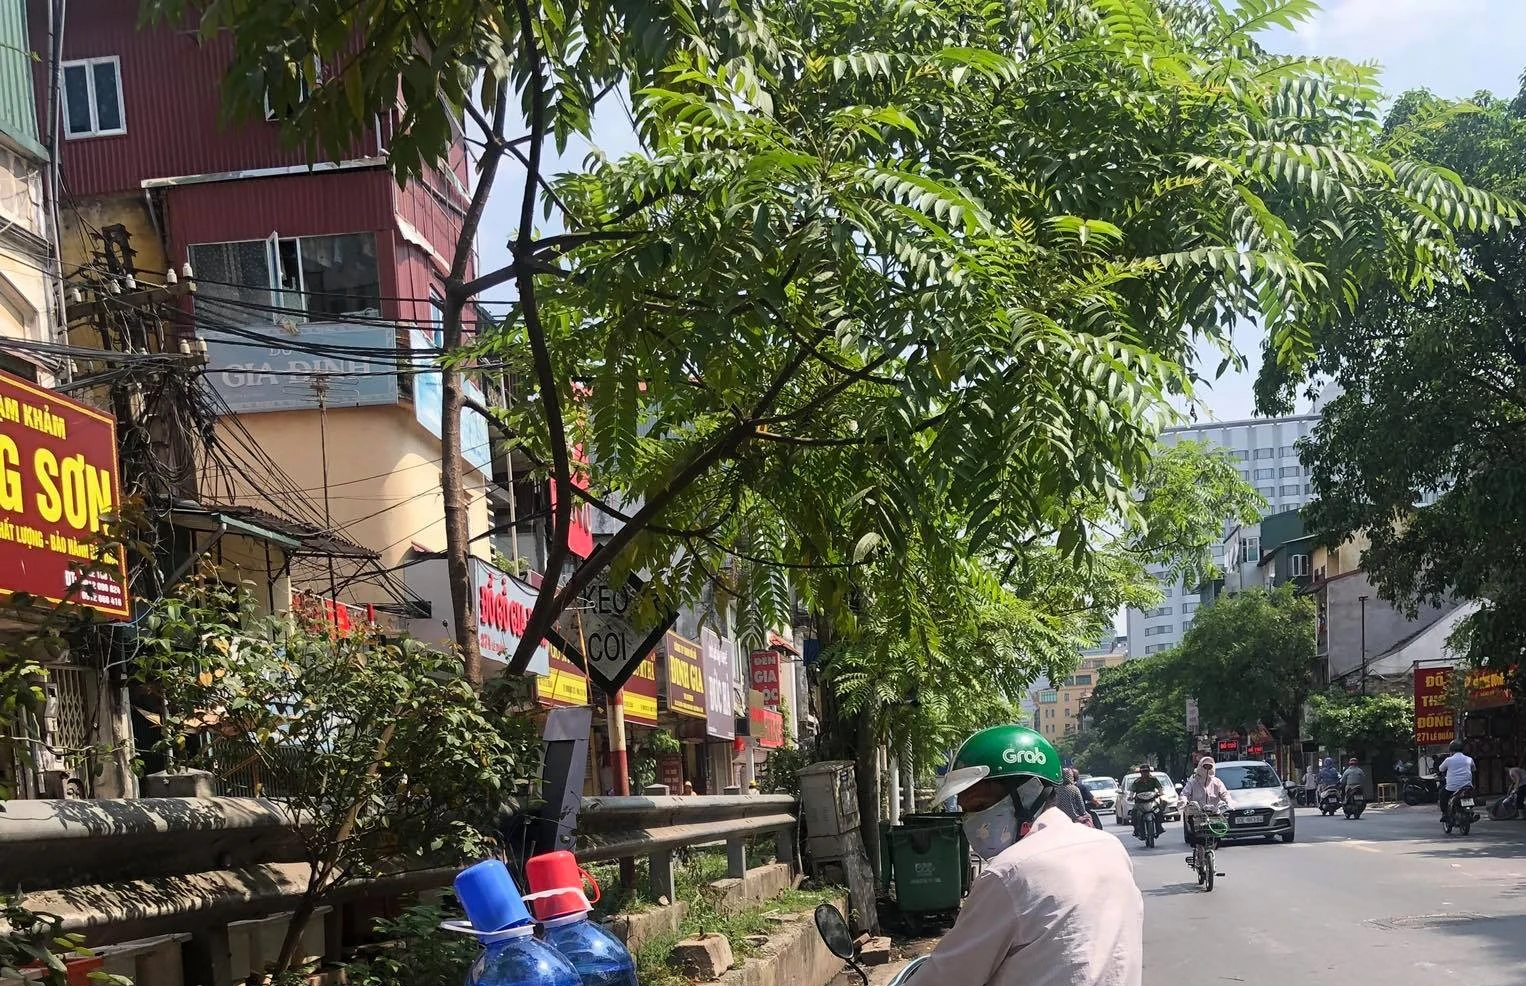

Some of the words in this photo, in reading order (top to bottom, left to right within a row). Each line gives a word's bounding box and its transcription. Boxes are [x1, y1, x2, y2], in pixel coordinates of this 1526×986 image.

[22, 403, 67, 440] KHẢM
[33, 447, 113, 537] SƠN
[1002, 747, 1047, 765] Grab
